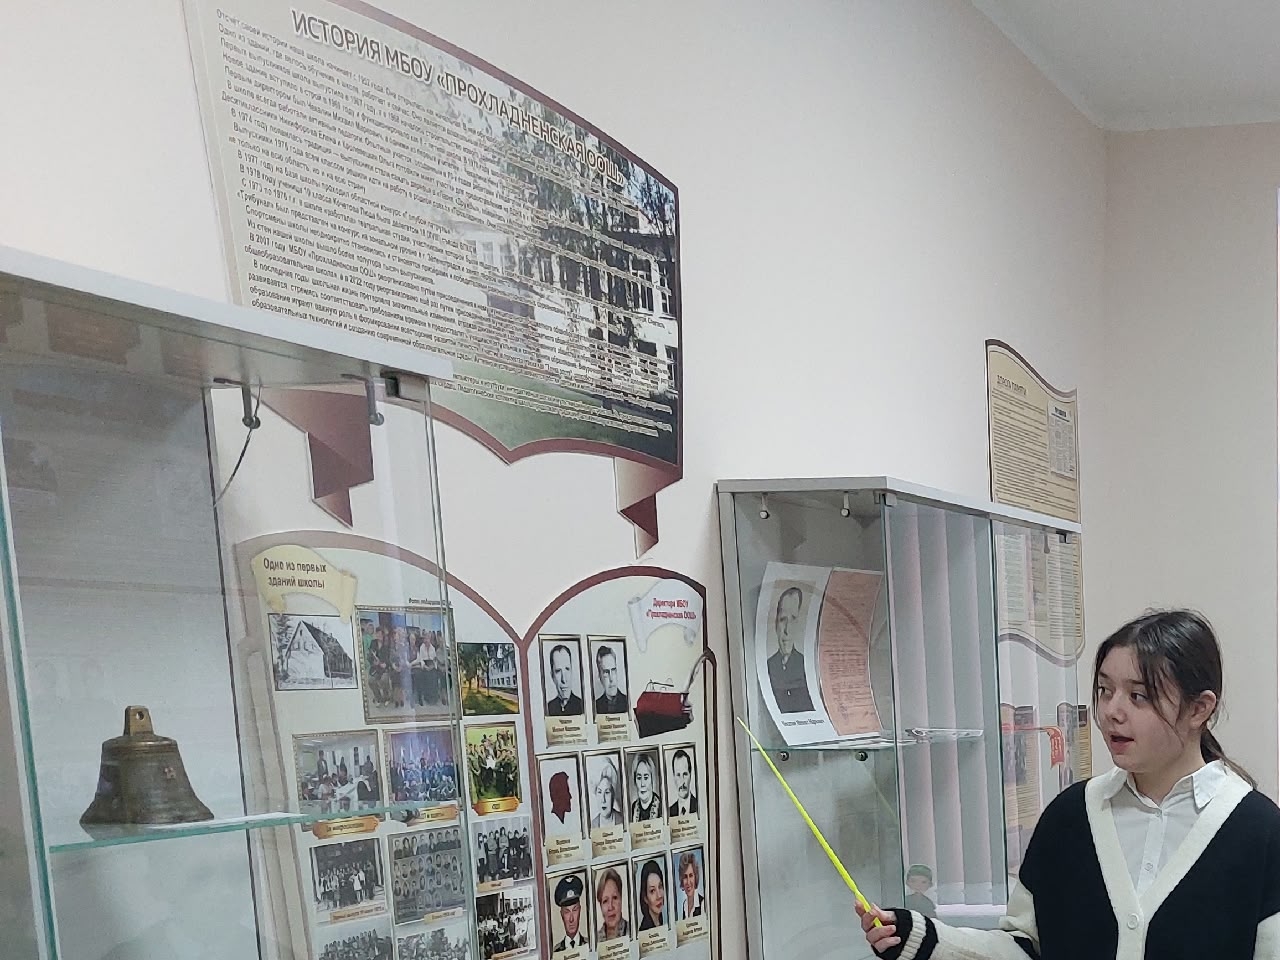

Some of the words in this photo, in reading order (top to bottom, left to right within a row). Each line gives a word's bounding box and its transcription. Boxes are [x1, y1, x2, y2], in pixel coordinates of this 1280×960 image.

[291, 9, 381, 62] ИСТОРИЯ
[385, 45, 432, 82] МБОУ
[437, 71, 584, 162] «ПРОХЛАДНЕНСКАЯ
[587, 149, 624, 185] ООШ»
[263, 557, 284, 571] Одно
[285, 561, 296, 571] из
[297, 563, 327, 575] первых
[268, 575, 297, 588] зданий
[297, 578, 325, 589] школы
